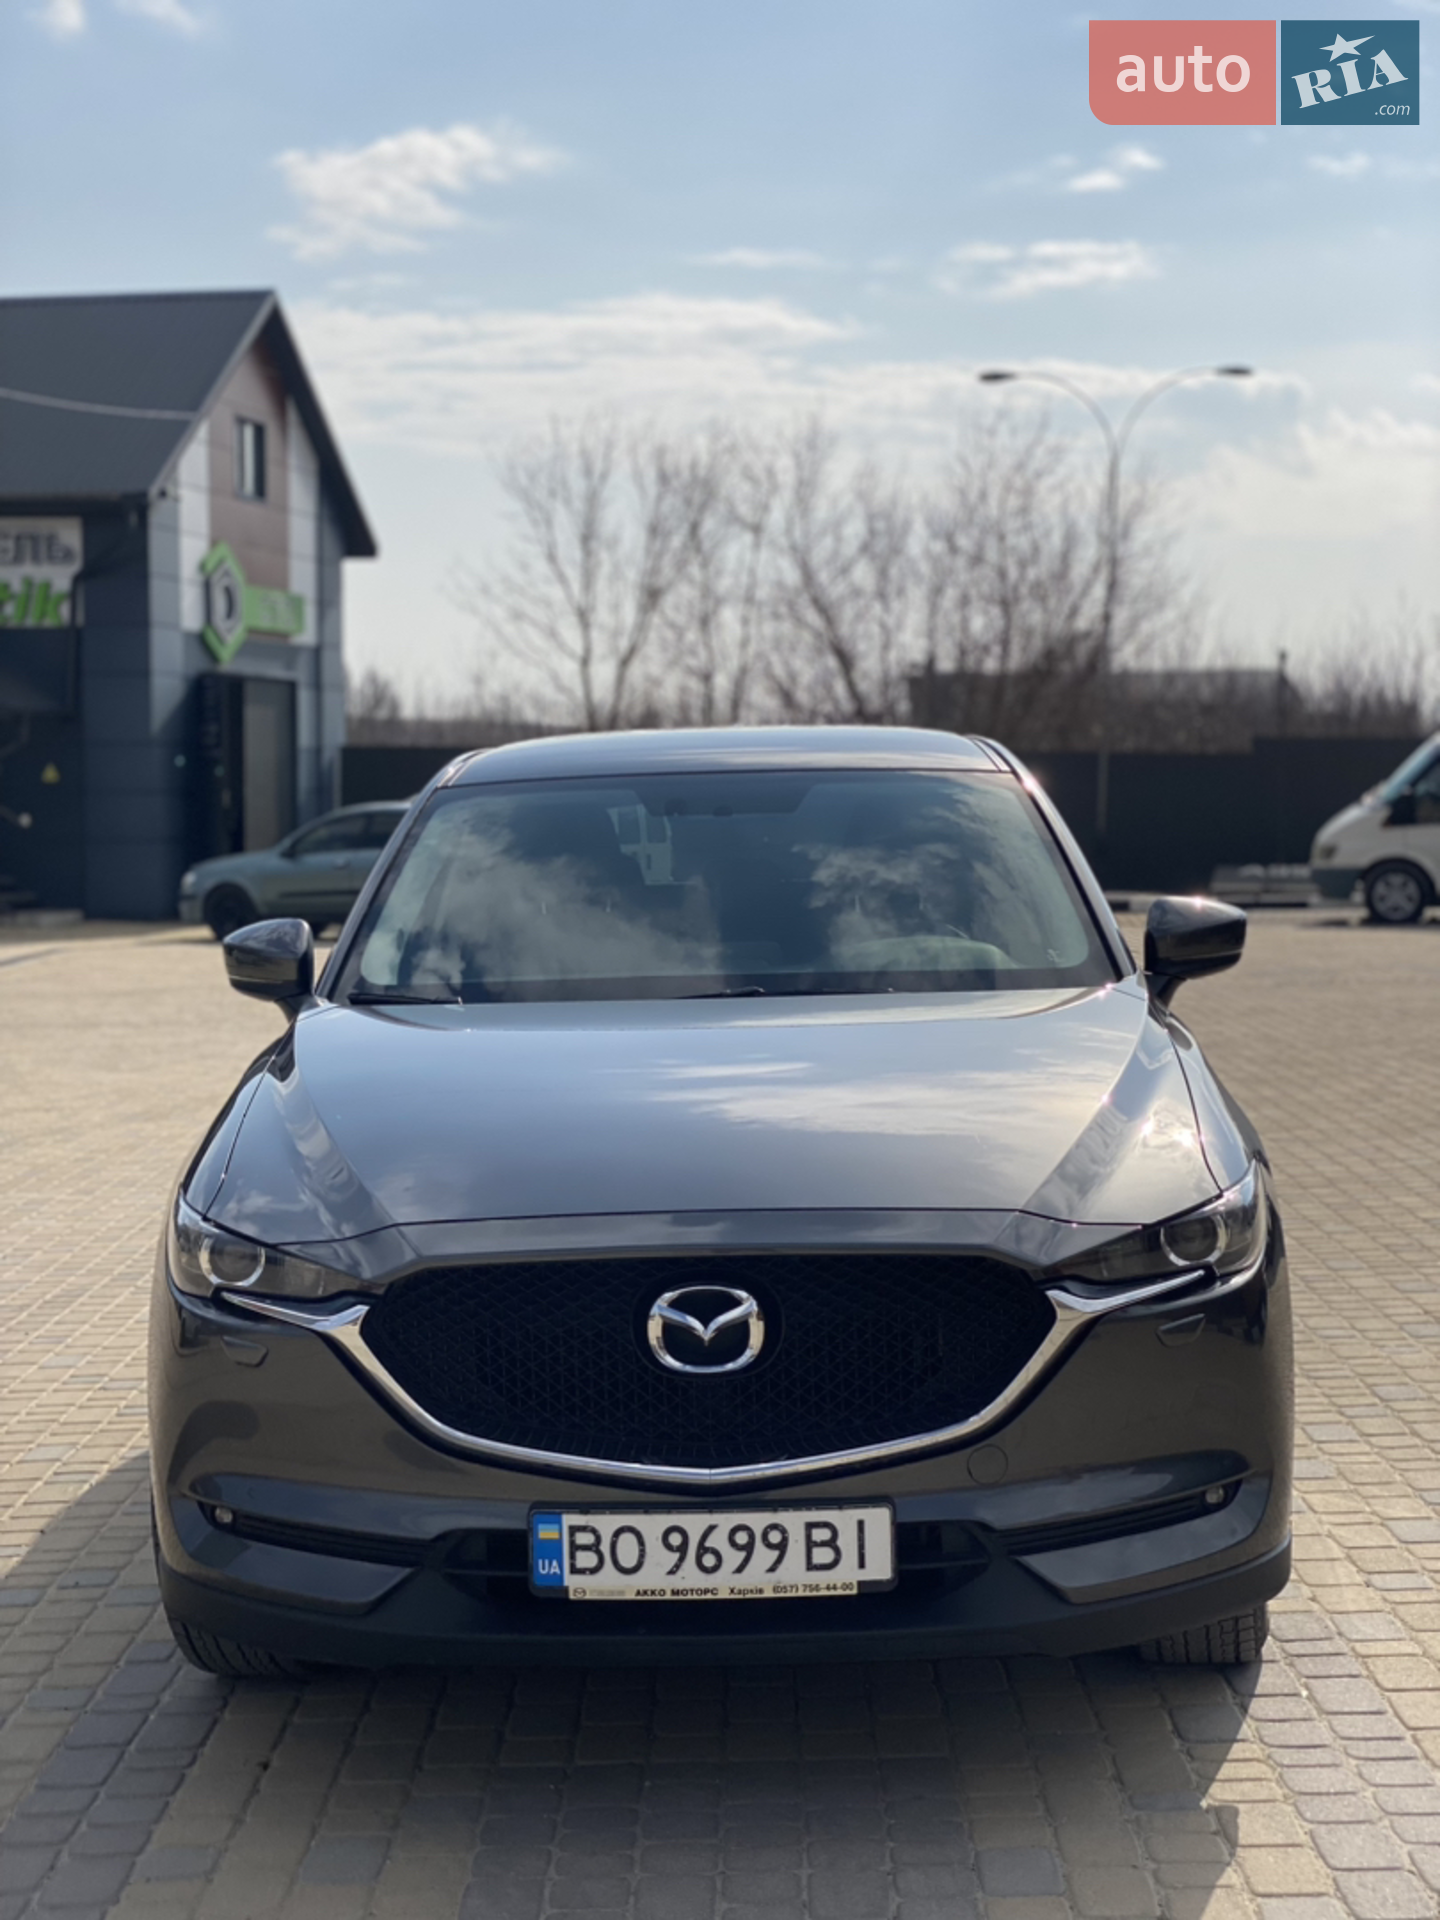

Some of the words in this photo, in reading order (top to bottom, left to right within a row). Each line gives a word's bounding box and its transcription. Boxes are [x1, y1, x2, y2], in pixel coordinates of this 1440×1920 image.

[567, 1523, 647, 1576] BO
[660, 1522, 790, 1576] 9699
[804, 1518, 867, 1573] BI
[538, 1559, 561, 1575] UA
[634, 1588, 666, 1597] АККО
[670, 1587, 719, 1597] МОТОРС
[728, 1586, 765, 1597] Харків
[772, 1583, 799, 1594] (057)
